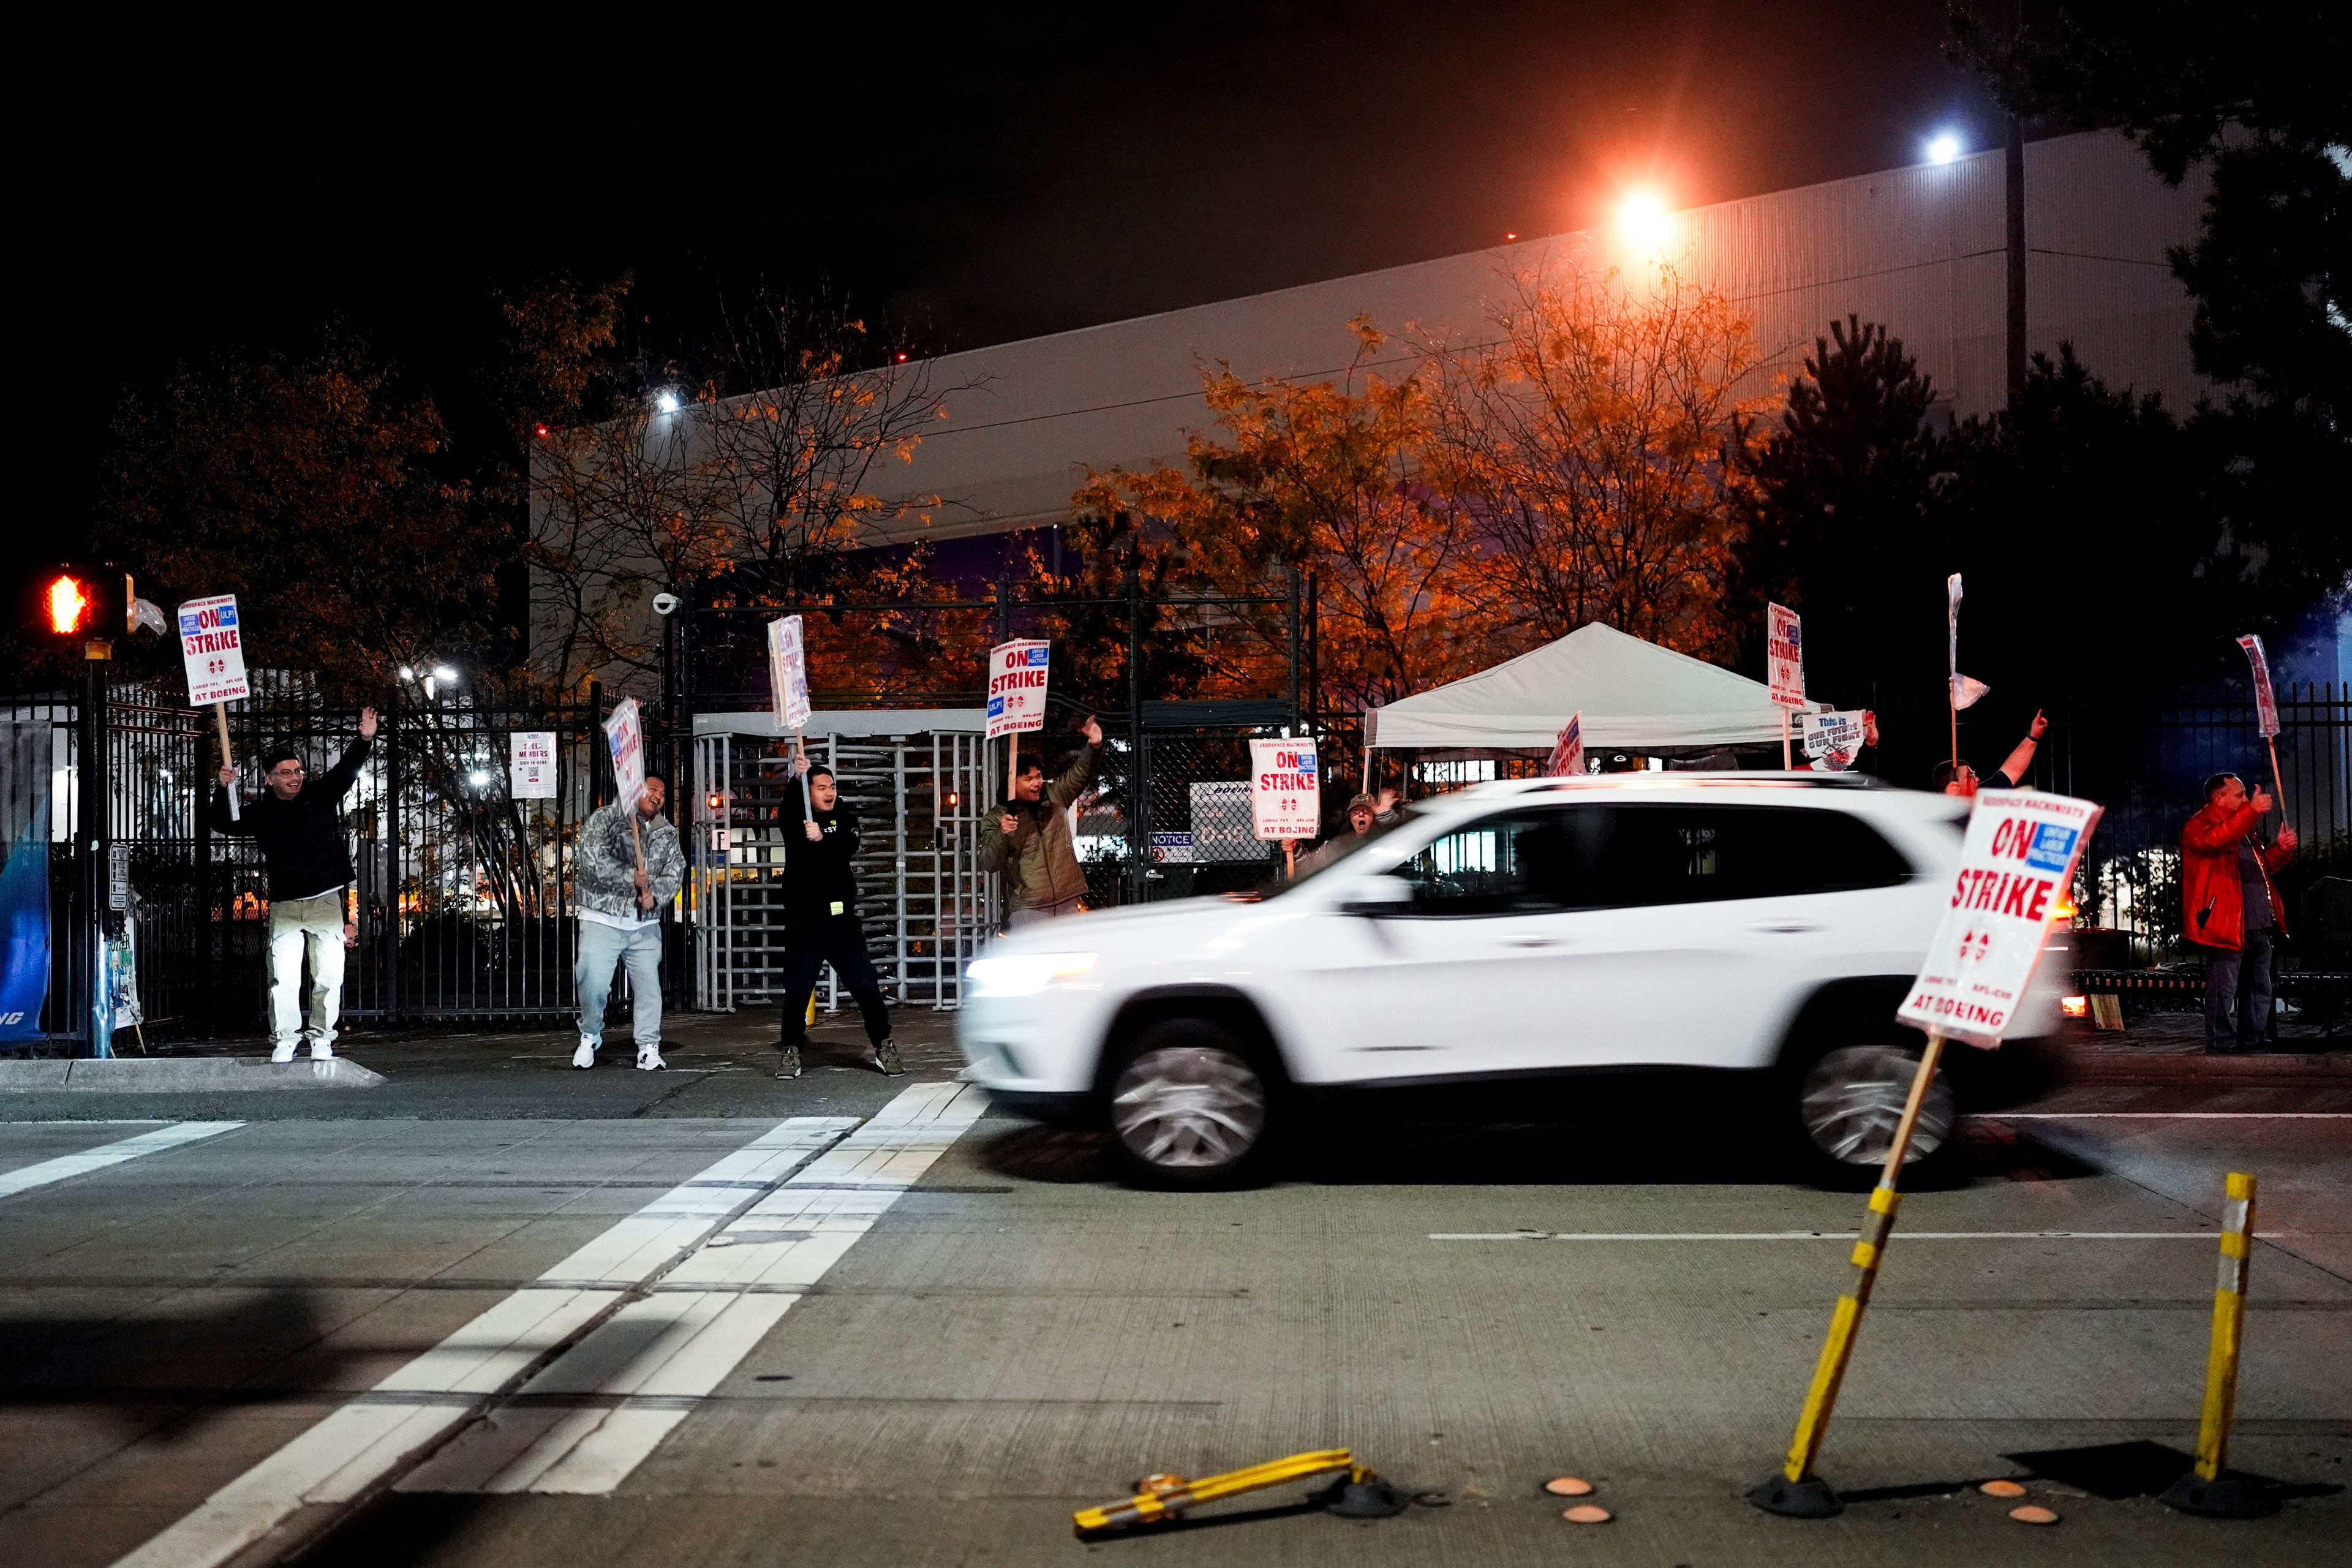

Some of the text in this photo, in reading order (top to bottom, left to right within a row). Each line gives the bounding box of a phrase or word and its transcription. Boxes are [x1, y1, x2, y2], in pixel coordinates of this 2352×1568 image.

[180, 597, 233, 609] AEROSPACE MACHINISTS
[198, 608, 221, 629] ON
[221, 610, 235, 619] ULP!
[185, 630, 239, 656] STRIKE
[992, 643, 1016, 654] AEROSPACE
[1769, 638, 1799, 663] STRIKE
[1006, 650, 1028, 669] ON
[991, 670, 1045, 695] STRIKE
[195, 686, 246, 702] AT BOEING
[1781, 695, 1804, 706] BOEING
[989, 701, 1003, 711] ULP!
[990, 720, 1041, 736] AT BOEING
[1819, 717, 1846, 726] This is
[617, 720, 628, 744] ON
[1808, 731, 1825, 741] OUR
[1809, 731, 1861, 748] OUR FIGHT
[615, 734, 637, 772] STRIKE
[1276, 751, 1298, 768] ON
[1261, 774, 1314, 791] STRIKE
[2025, 799, 2086, 818] MACHINISTS
[1152, 835, 1189, 844] NOTICE
[1991, 817, 2038, 860] ON
[1951, 869, 2054, 922] STRIKE
[1912, 995, 2004, 1027] AT BOEING
